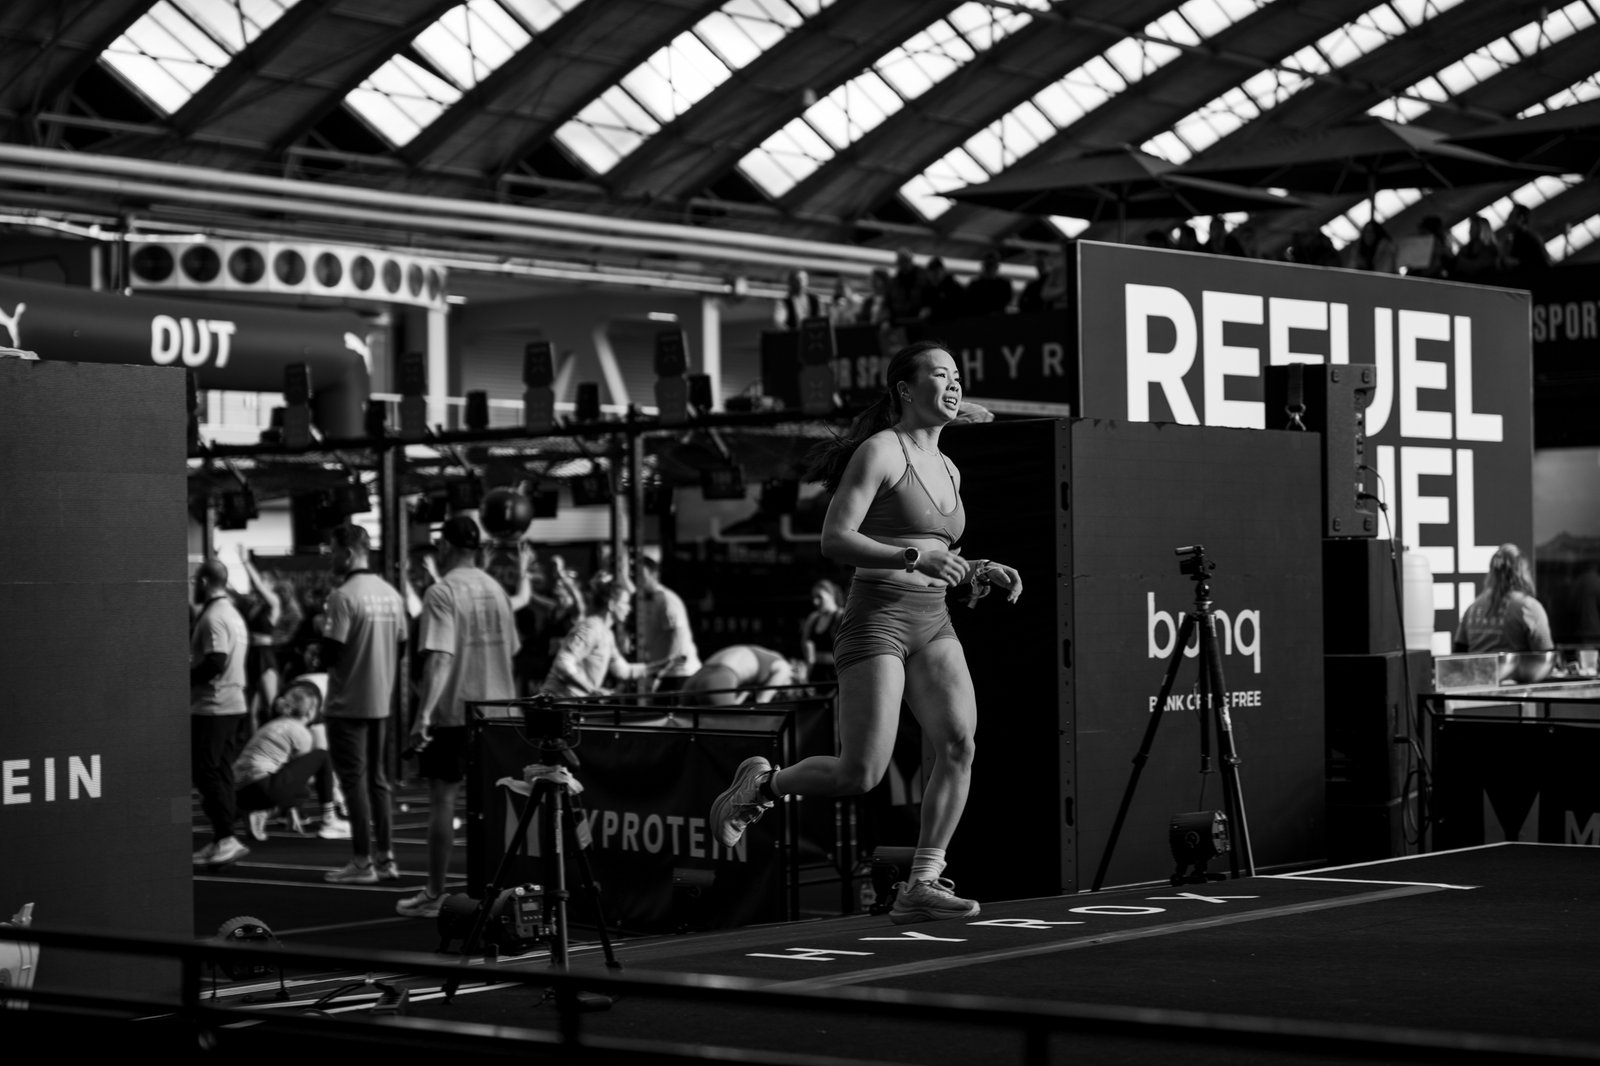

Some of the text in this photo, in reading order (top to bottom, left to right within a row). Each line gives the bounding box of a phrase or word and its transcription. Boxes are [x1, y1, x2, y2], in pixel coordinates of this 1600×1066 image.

[1533, 299, 1600, 344] SPOR
[1125, 283, 1503, 442] REFUEL
[1148, 694, 1185, 712] BNK
[1231, 690, 1262, 708] FREE
[3, 754, 102, 805] EIN
[580, 808, 748, 863] YPROTEIN
[744, 891, 1261, 962] HYROX
